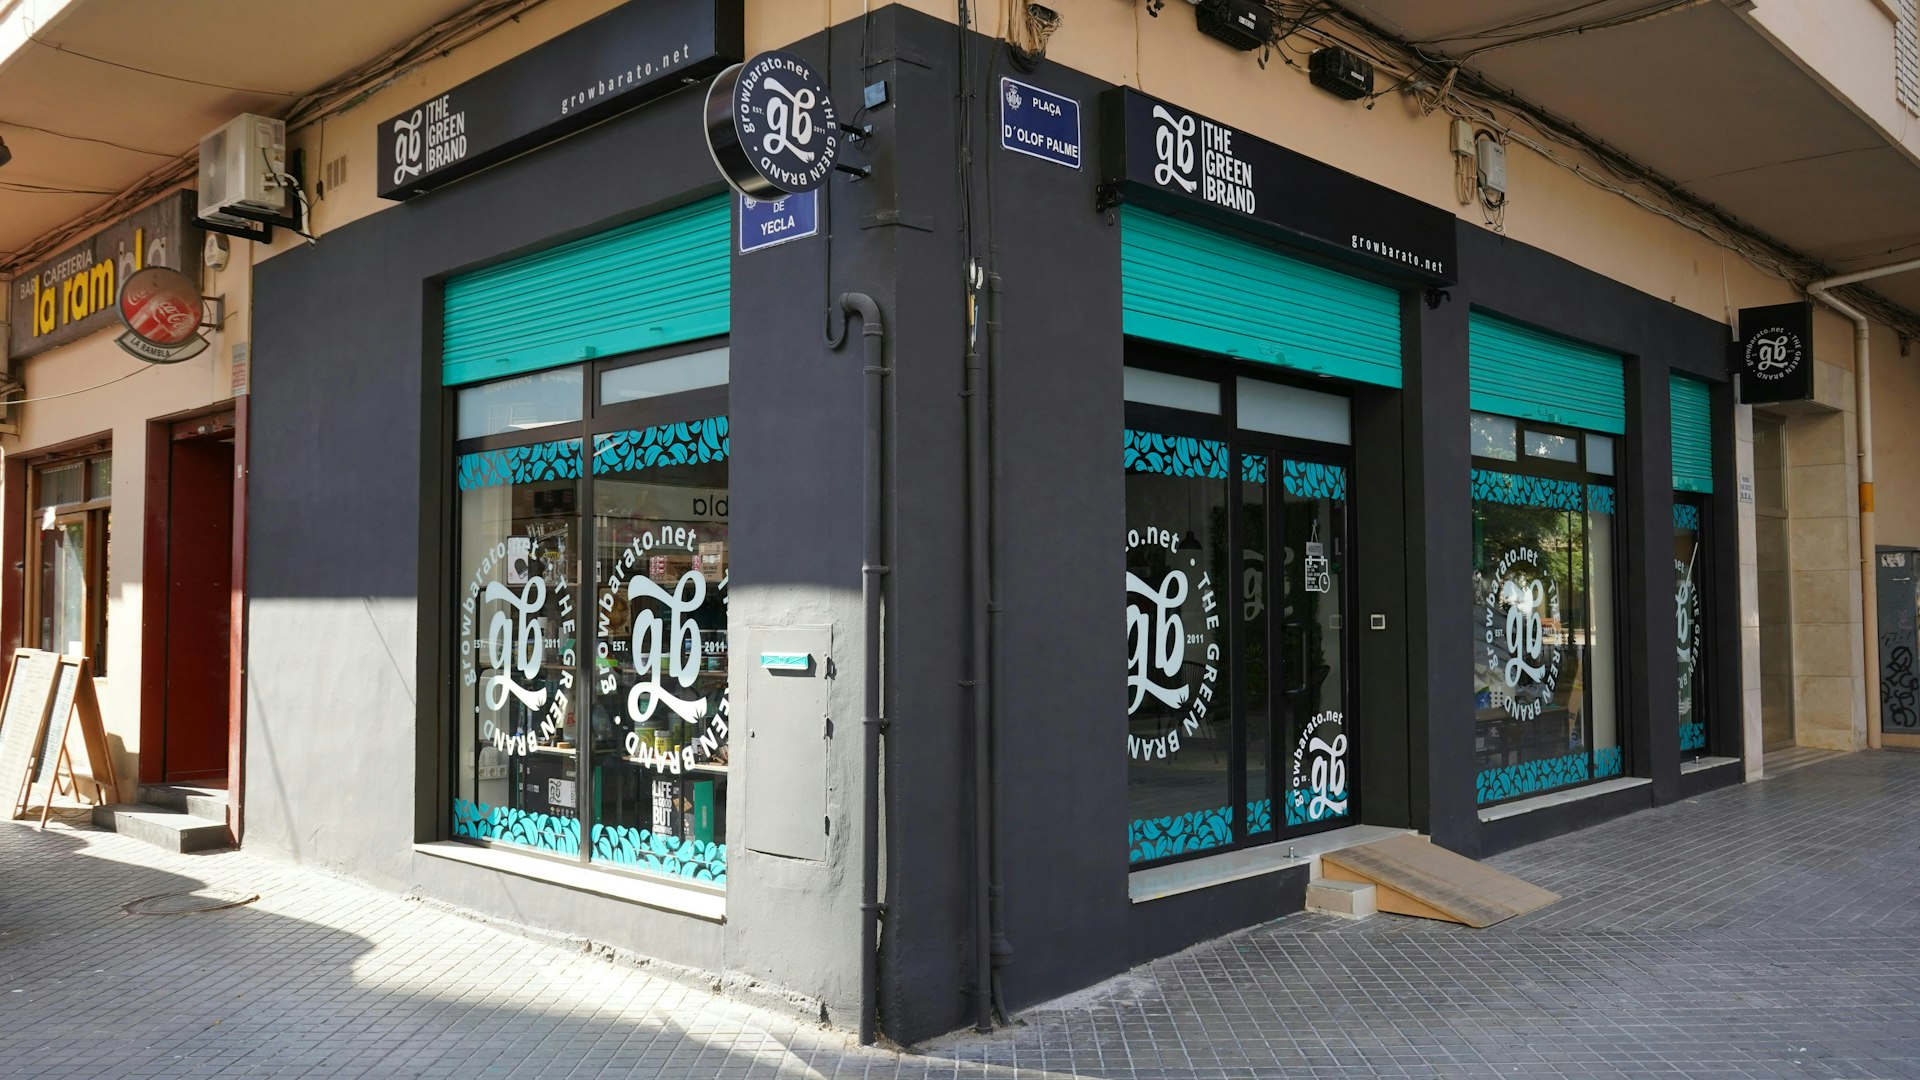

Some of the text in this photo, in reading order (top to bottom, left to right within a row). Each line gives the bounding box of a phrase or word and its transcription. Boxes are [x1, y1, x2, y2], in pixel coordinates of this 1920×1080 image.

[562, 43, 689, 115] growbarato.net
[740, 57, 810, 135] growbarato.net
[428, 94, 450, 124] THE
[752, 106, 764, 116] EST.
[1032, 97, 1062, 116] PLAÇA
[428, 111, 465, 148] GREEN
[760, 95, 837, 186] THE GREEN BRAND
[813, 125, 826, 135] 2011
[1046, 136, 1079, 159] PALME
[1204, 121, 1233, 156] THE
[428, 134, 468, 172] BRAND
[1205, 149, 1253, 189] GREEN
[773, 200, 785, 213] DE
[1206, 175, 1256, 215] BRAND
[761, 215, 796, 236] YECLA
[1351, 234, 1443, 274] growbarato.net
[20, 248, 93, 300] BAR CAFETERIA
[33, 274, 56, 337] la
[130, 336, 172, 358] LA RAMBLA
[1745, 327, 1785, 367] growbarato.net
[1791, 334, 1802, 349] THE
[1757, 372, 1785, 381] BRAND
[1785, 350, 1802, 374] GREEN
[461, 537, 541, 688] growbarato.net
[554, 574, 576, 635] THE
[597, 524, 697, 695] growbarato.net
[1197, 571, 1221, 630] THE
[1485, 546, 1539, 671] growbarato.net
[544, 638, 561, 649] 2011
[612, 641, 629, 652] EST.
[704, 641, 725, 653] 2011
[1186, 634, 1204, 645] 2011
[1494, 629, 1505, 638] EST.
[540, 648, 577, 741] GREEN
[1183, 643, 1221, 737] GREEN
[1503, 696, 1542, 722] BRAND
[482, 719, 538, 757] BRAND
[625, 731, 696, 775] BRAND
[1127, 729, 1181, 762] BRAN
[1293, 710, 1344, 808] growbarato.net
[652, 780, 673, 799] LIFE
[652, 805, 673, 827] BUT
